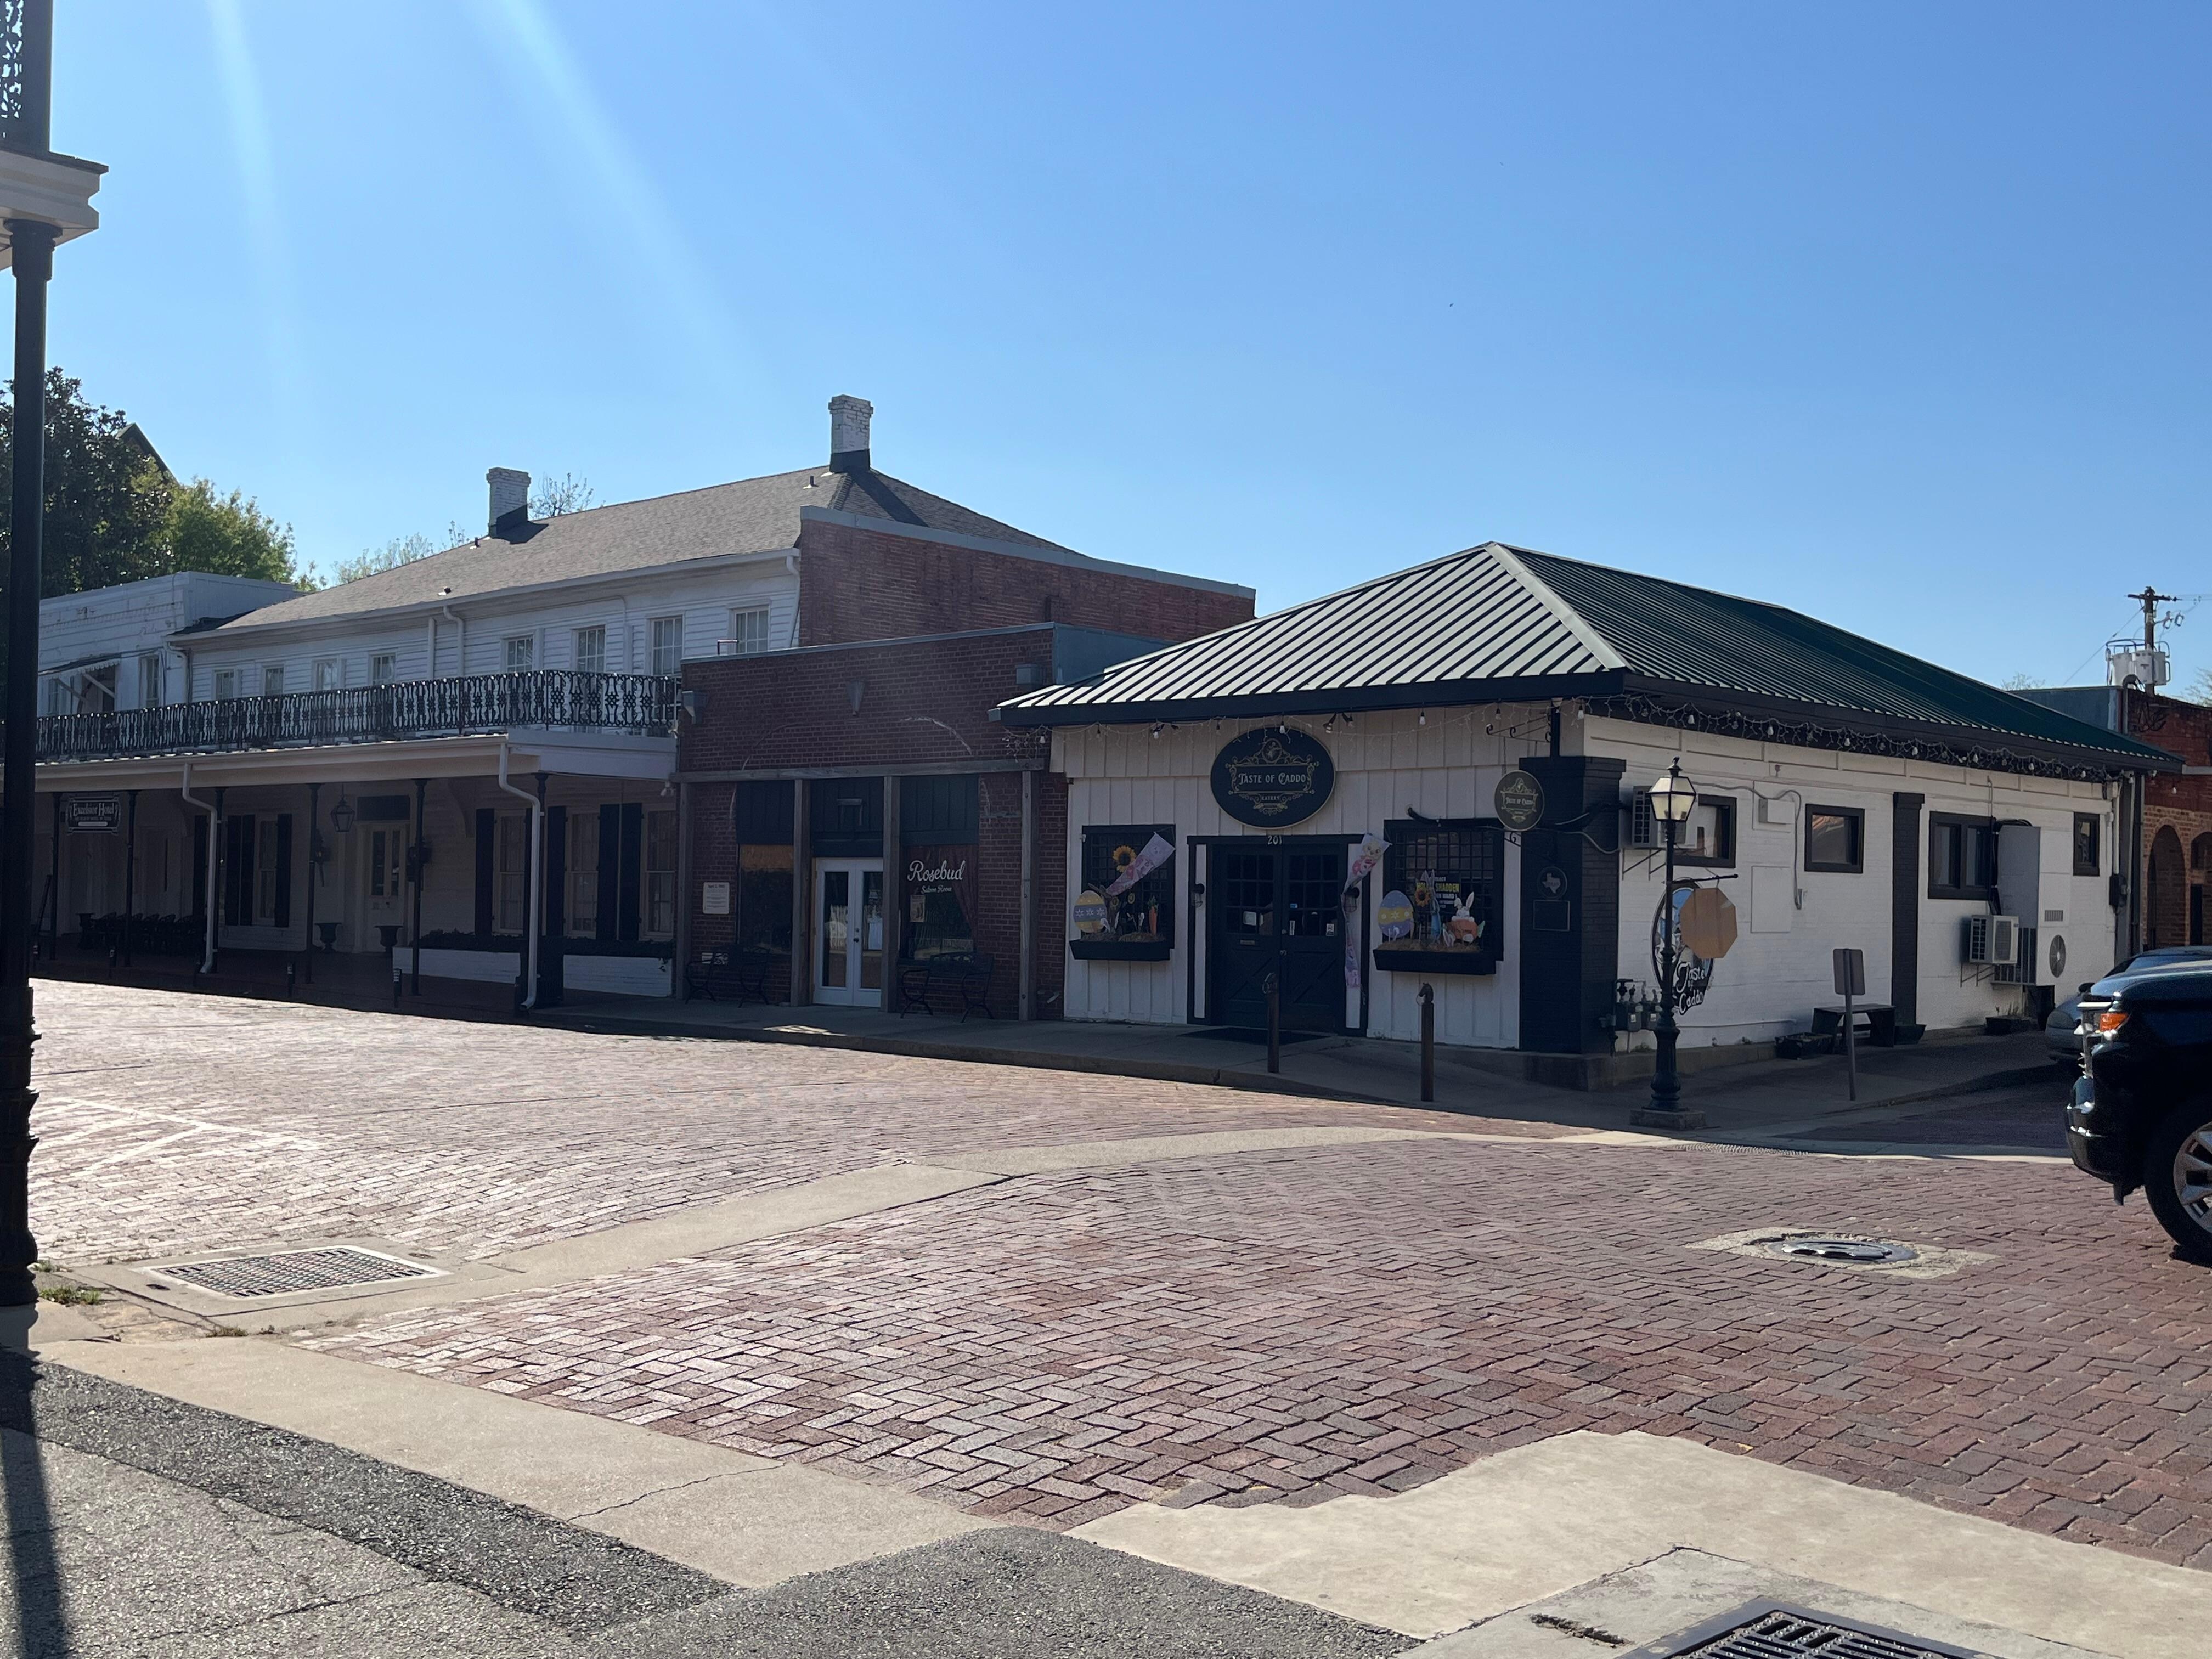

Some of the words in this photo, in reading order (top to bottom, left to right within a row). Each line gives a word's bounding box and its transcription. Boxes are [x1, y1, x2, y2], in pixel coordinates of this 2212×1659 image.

[1238, 773, 1262, 785] TASTE
[1265, 774, 1275, 783] OF
[1278, 772, 1306, 785] CADDO
[73, 803, 98, 816] Excelsior
[98, 803, 114, 816] Hotel
[1267, 835, 1283, 845] 201
[907, 860, 966, 882] Rosebud
[1435, 883, 1460, 893] SHADDEN
[1676, 962, 1705, 993] Taste
[1679, 989, 1703, 1014] Caddo
